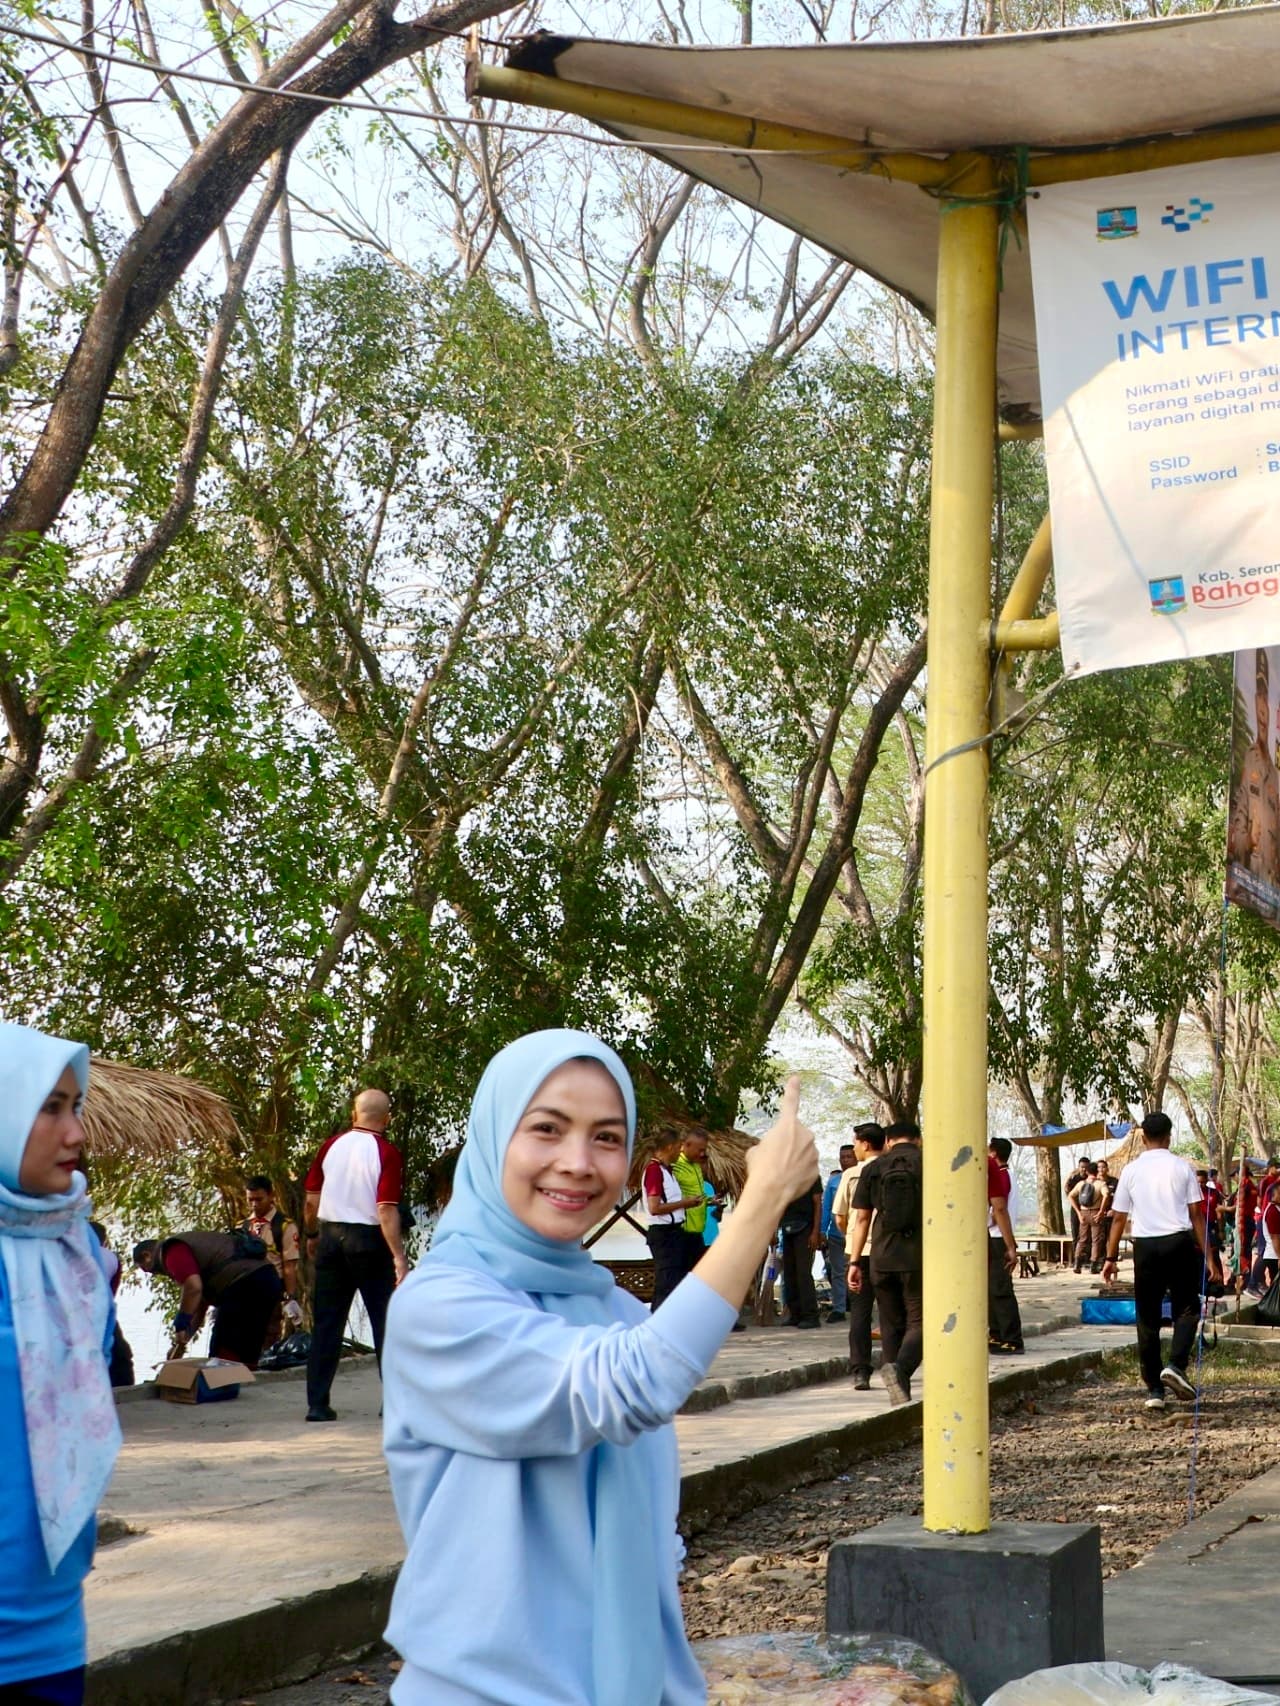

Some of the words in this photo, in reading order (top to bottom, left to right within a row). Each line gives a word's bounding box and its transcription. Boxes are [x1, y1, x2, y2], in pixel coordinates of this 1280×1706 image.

[1101, 256, 1268, 320] WIFI
[1126, 377, 1191, 399] Nikmati
[1195, 370, 1234, 386] WiFi
[1127, 395, 1189, 415] Serang
[1194, 384, 1263, 404] sebagai
[1128, 412, 1195, 432] layanan
[1200, 402, 1255, 420] digital
[1149, 456, 1191, 473] SSID
[1151, 466, 1238, 490] Password
[1198, 570, 1235, 584] Kab.
